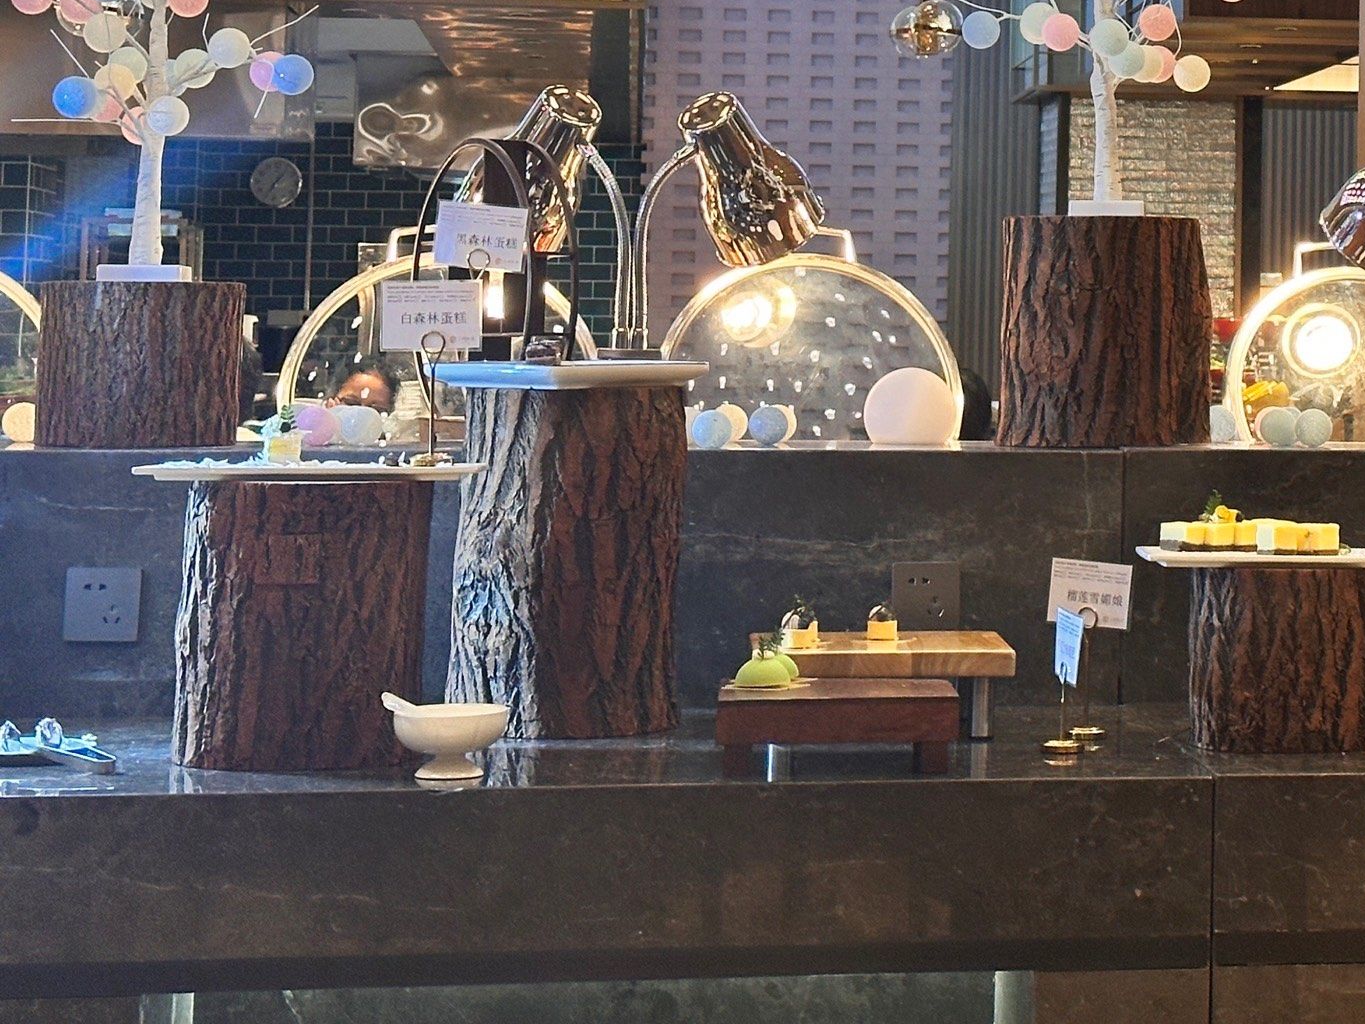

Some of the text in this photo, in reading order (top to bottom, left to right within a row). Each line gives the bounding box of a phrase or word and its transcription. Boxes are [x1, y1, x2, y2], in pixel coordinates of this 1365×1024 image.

[456, 232, 518, 249] 黑森林蛋糕
[401, 311, 467, 325] 白森林蛋糕
[1067, 589, 1123, 607] 榴莲雪媚娘
